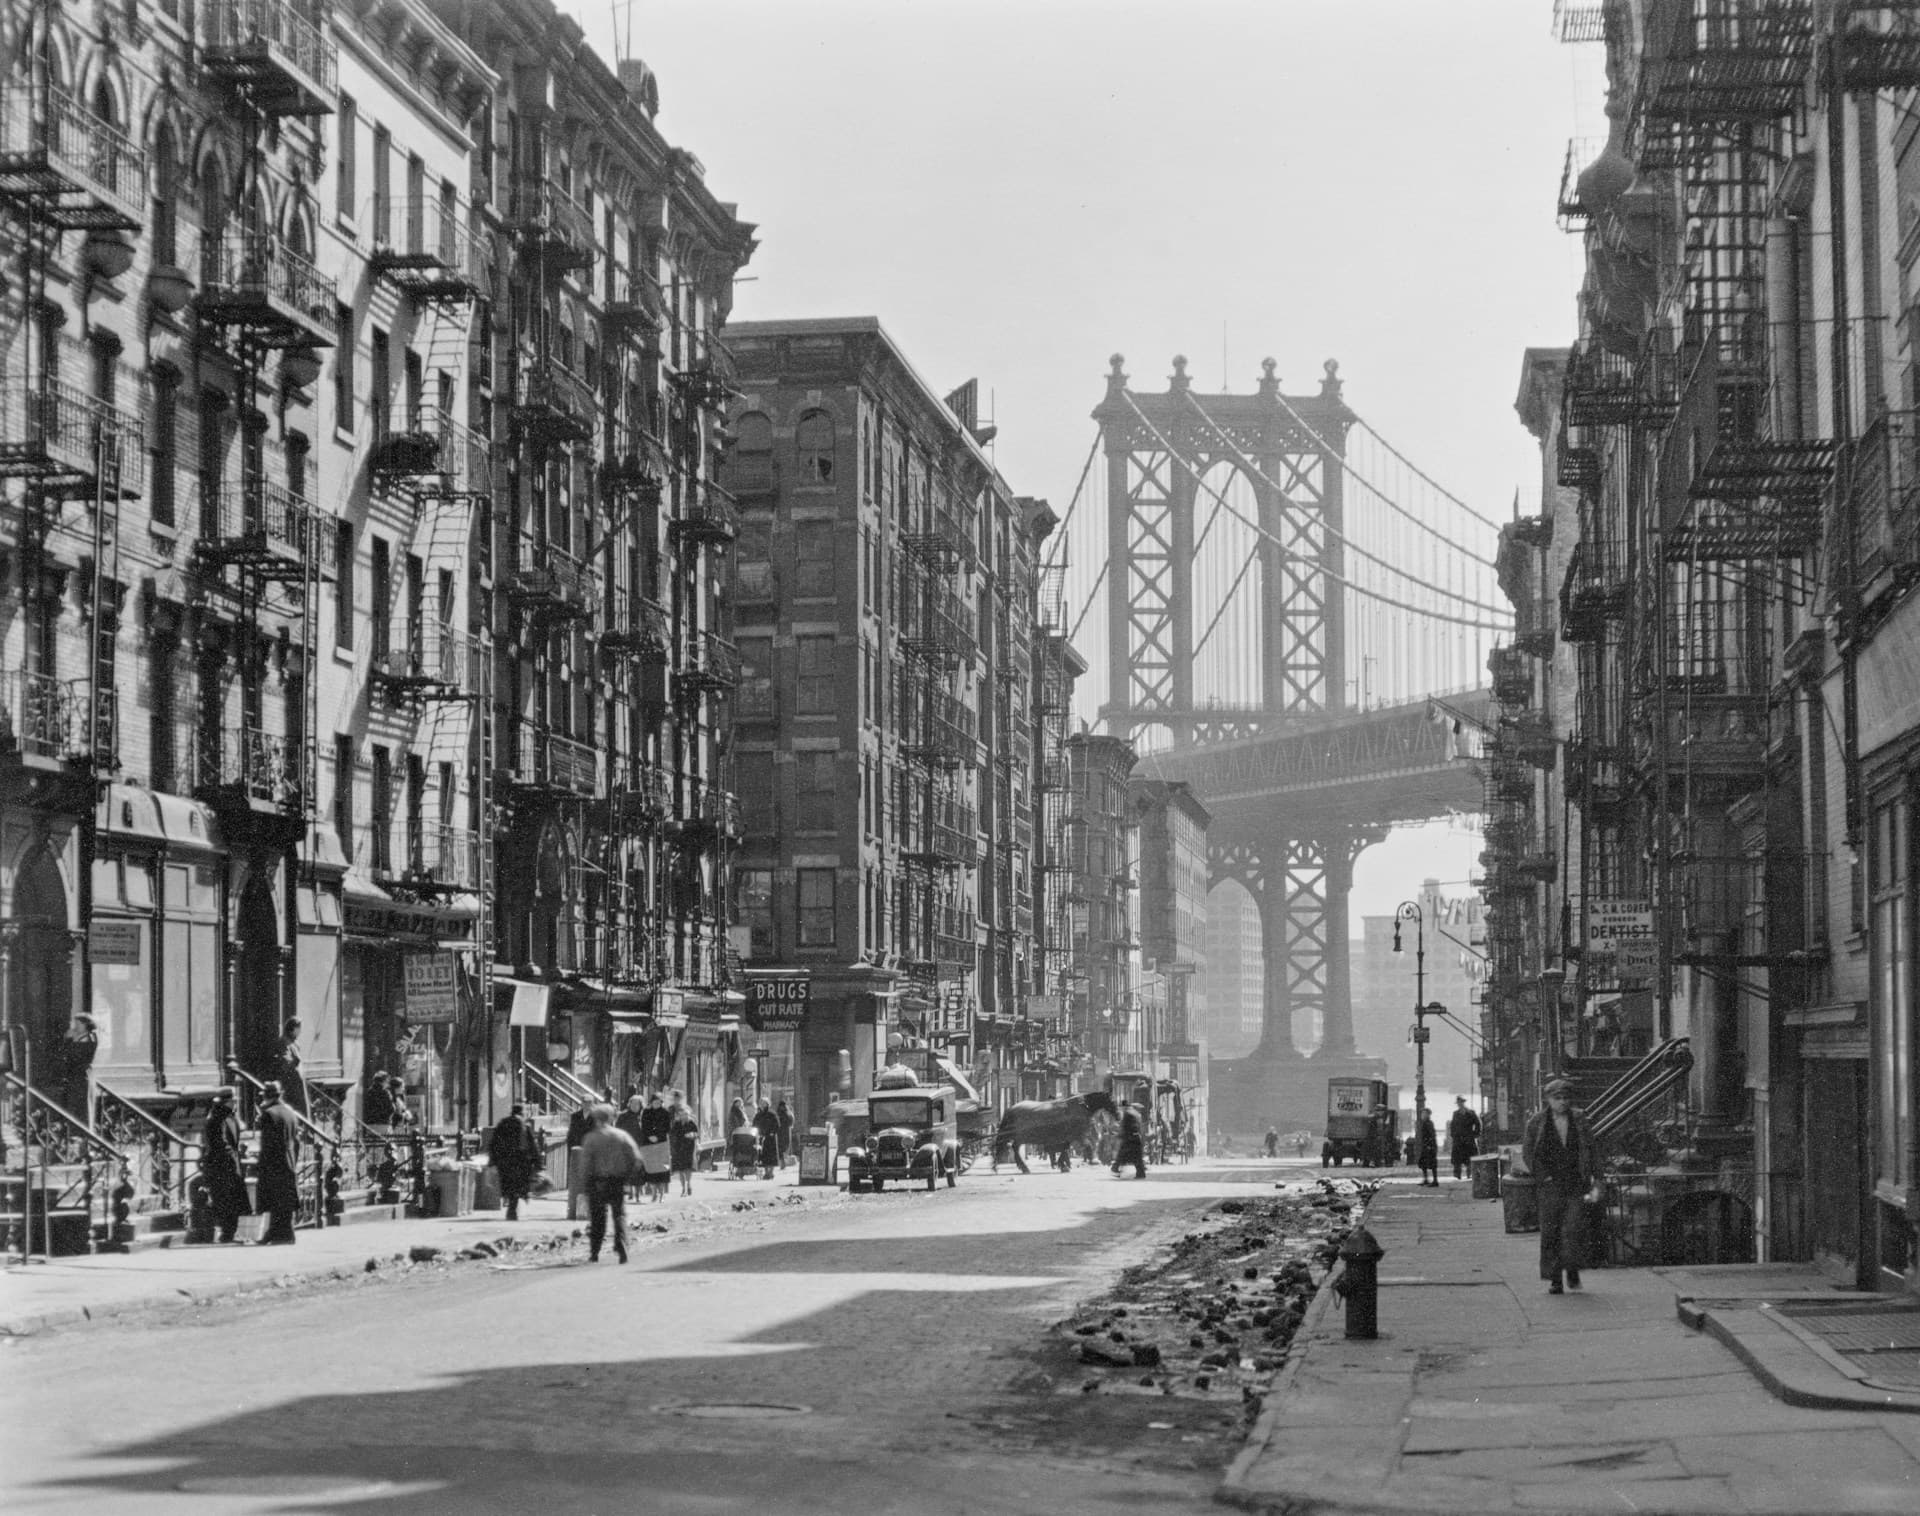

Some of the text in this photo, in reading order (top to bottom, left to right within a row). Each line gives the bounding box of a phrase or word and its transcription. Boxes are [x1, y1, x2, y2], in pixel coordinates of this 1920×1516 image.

[1591, 925, 1649, 939] DENTIST
[407, 966, 451, 980] TO LET
[757, 983, 807, 999] DRUGS
[759, 1003, 804, 1016] CUT RATE
[763, 1020, 800, 1031] PHARMACY
